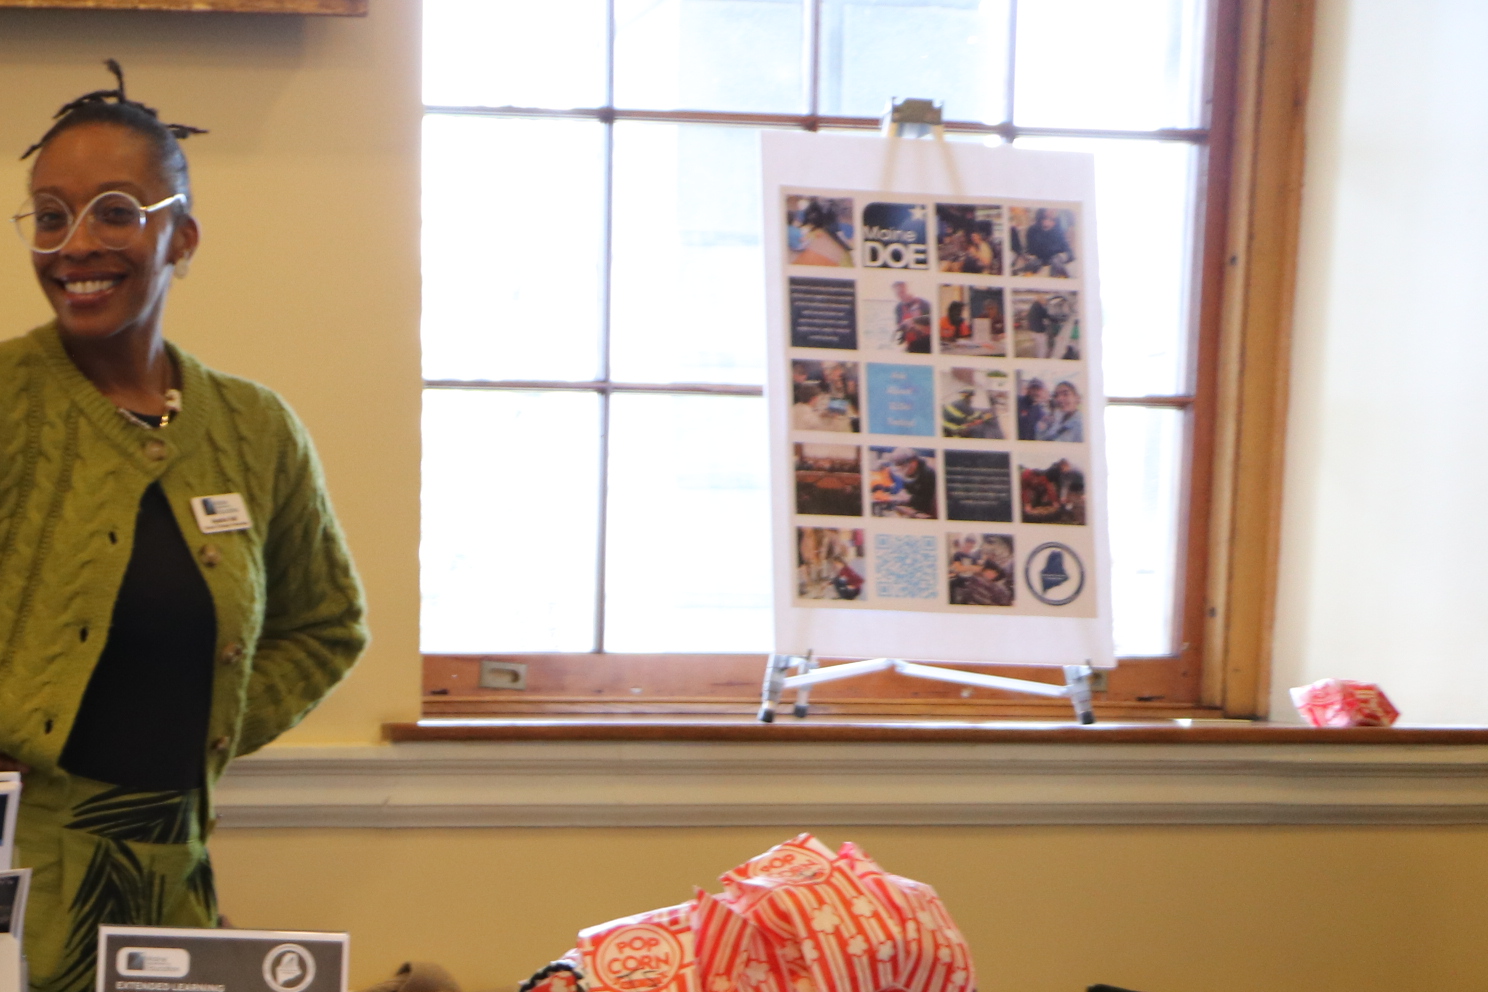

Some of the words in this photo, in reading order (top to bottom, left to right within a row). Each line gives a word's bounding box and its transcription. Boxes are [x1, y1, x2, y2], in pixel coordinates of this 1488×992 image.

[864, 241, 929, 269] DOE
[616, 936, 660, 954] POP
[608, 952, 670, 974] CORN
[115, 981, 170, 992] EXTENDED
